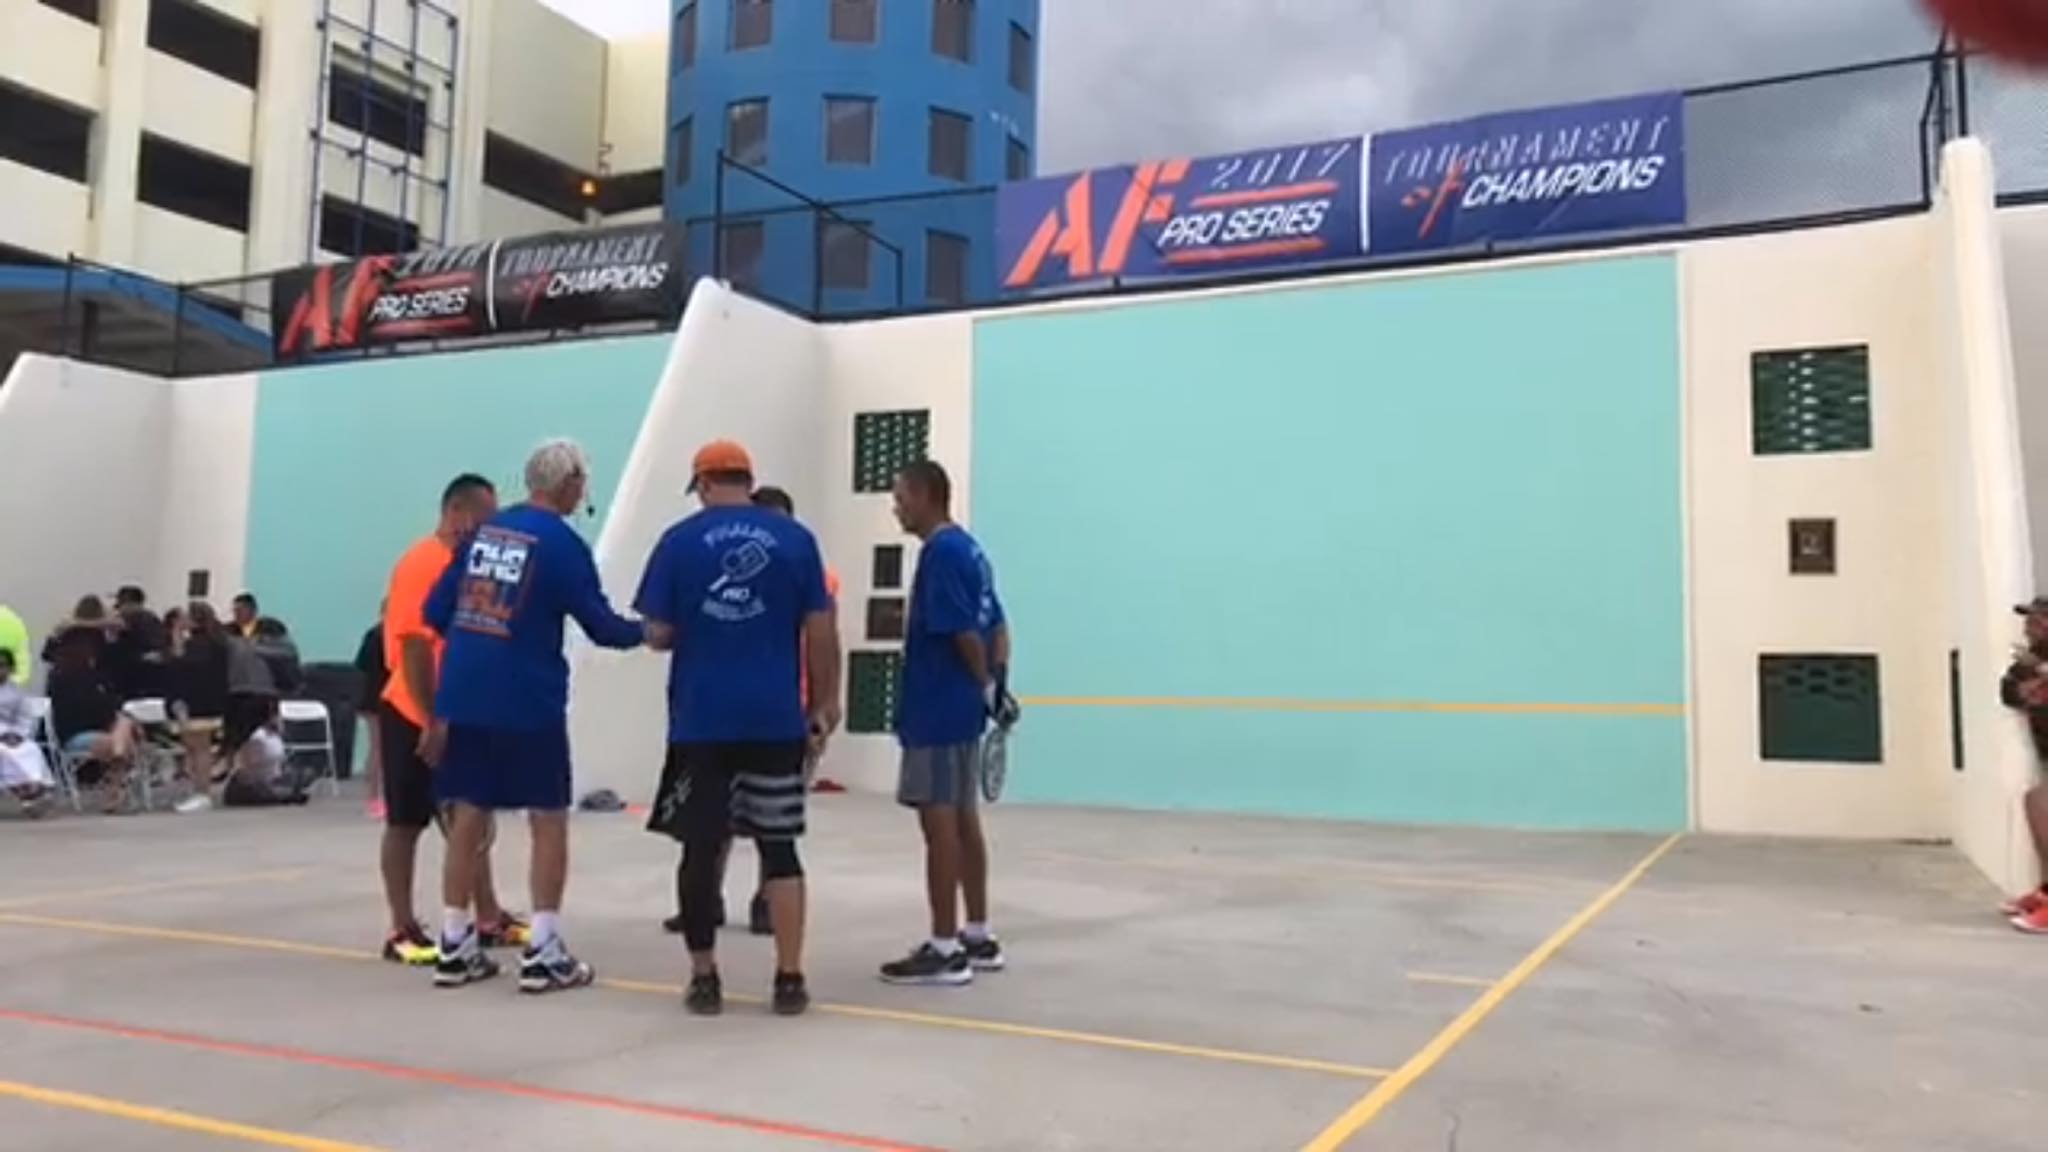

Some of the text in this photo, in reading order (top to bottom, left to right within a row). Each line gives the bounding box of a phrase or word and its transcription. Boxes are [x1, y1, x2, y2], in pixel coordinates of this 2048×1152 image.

[1209, 143, 1350, 190] 2017
[1384, 115, 1668, 184] TOURNAMENT
[1462, 155, 1664, 208] CHAMPIONS
[1157, 200, 1329, 247] PRO SERIES
[546, 262, 668, 298] CHAMPIONS
[368, 286, 471, 322] PRO SERIES
